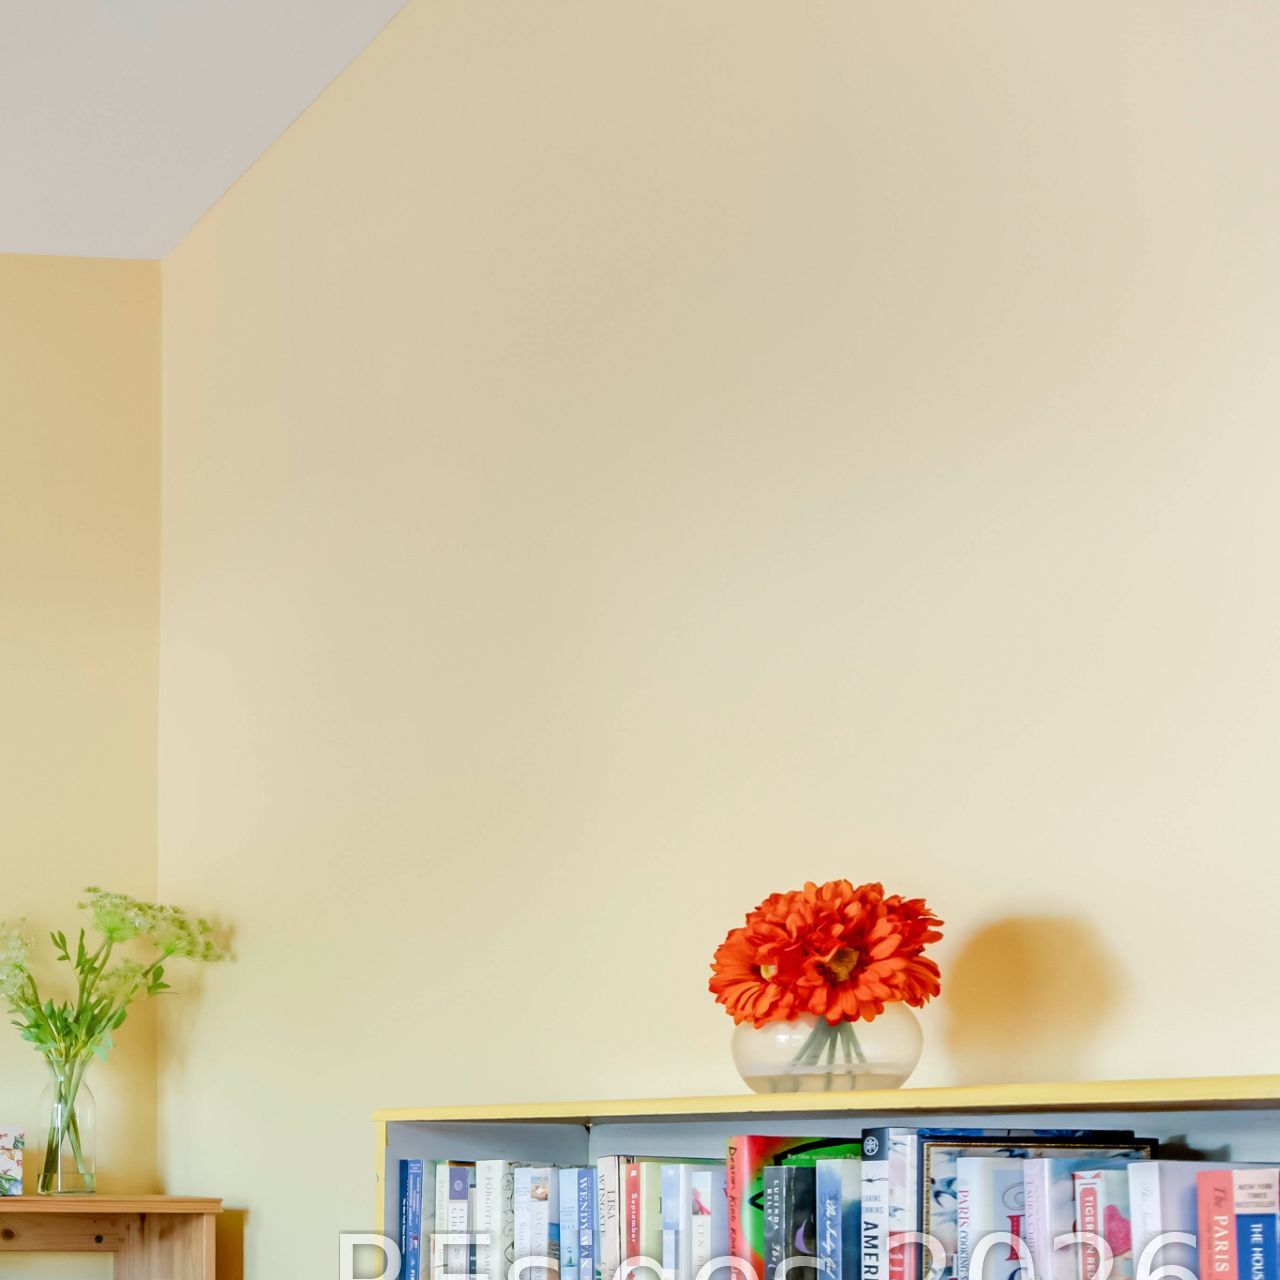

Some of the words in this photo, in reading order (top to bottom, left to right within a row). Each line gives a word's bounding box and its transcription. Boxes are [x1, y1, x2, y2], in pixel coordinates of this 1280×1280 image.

[579, 1177, 590, 1232] WENDY
[607, 1188, 616, 1220] LISA
[1213, 1215, 1230, 1273] PARIS
[1250, 1224, 1263, 1244] THE
